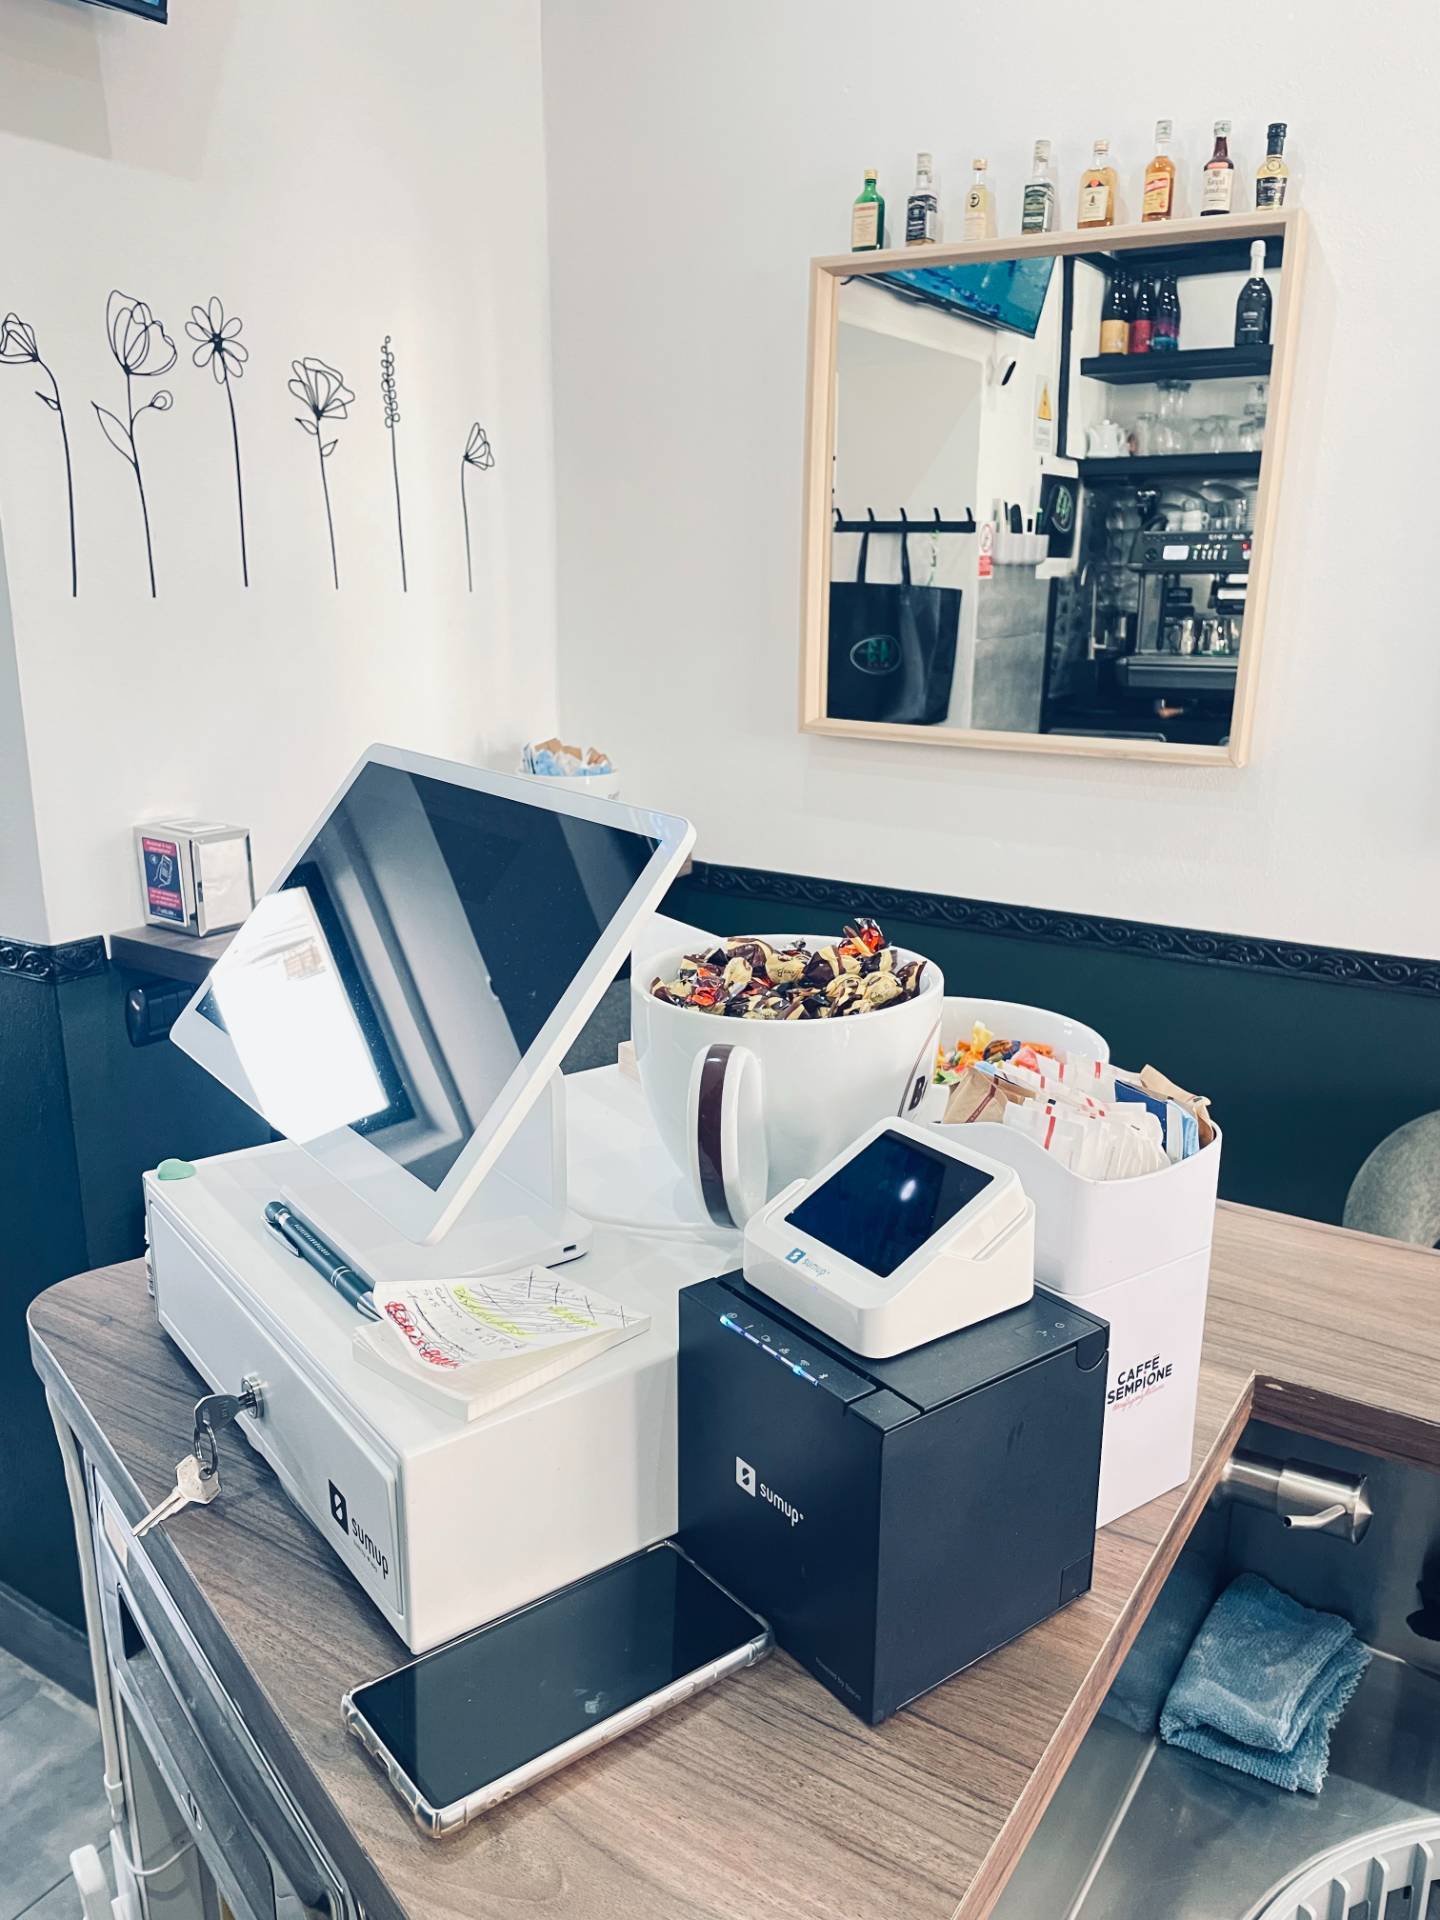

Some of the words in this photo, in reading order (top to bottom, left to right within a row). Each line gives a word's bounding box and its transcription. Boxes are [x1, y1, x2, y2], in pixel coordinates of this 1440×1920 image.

[1107, 1363, 1173, 1405] SEMPIONE
[759, 1483, 799, 1527] sumup
[352, 1517, 389, 1580] sumup
